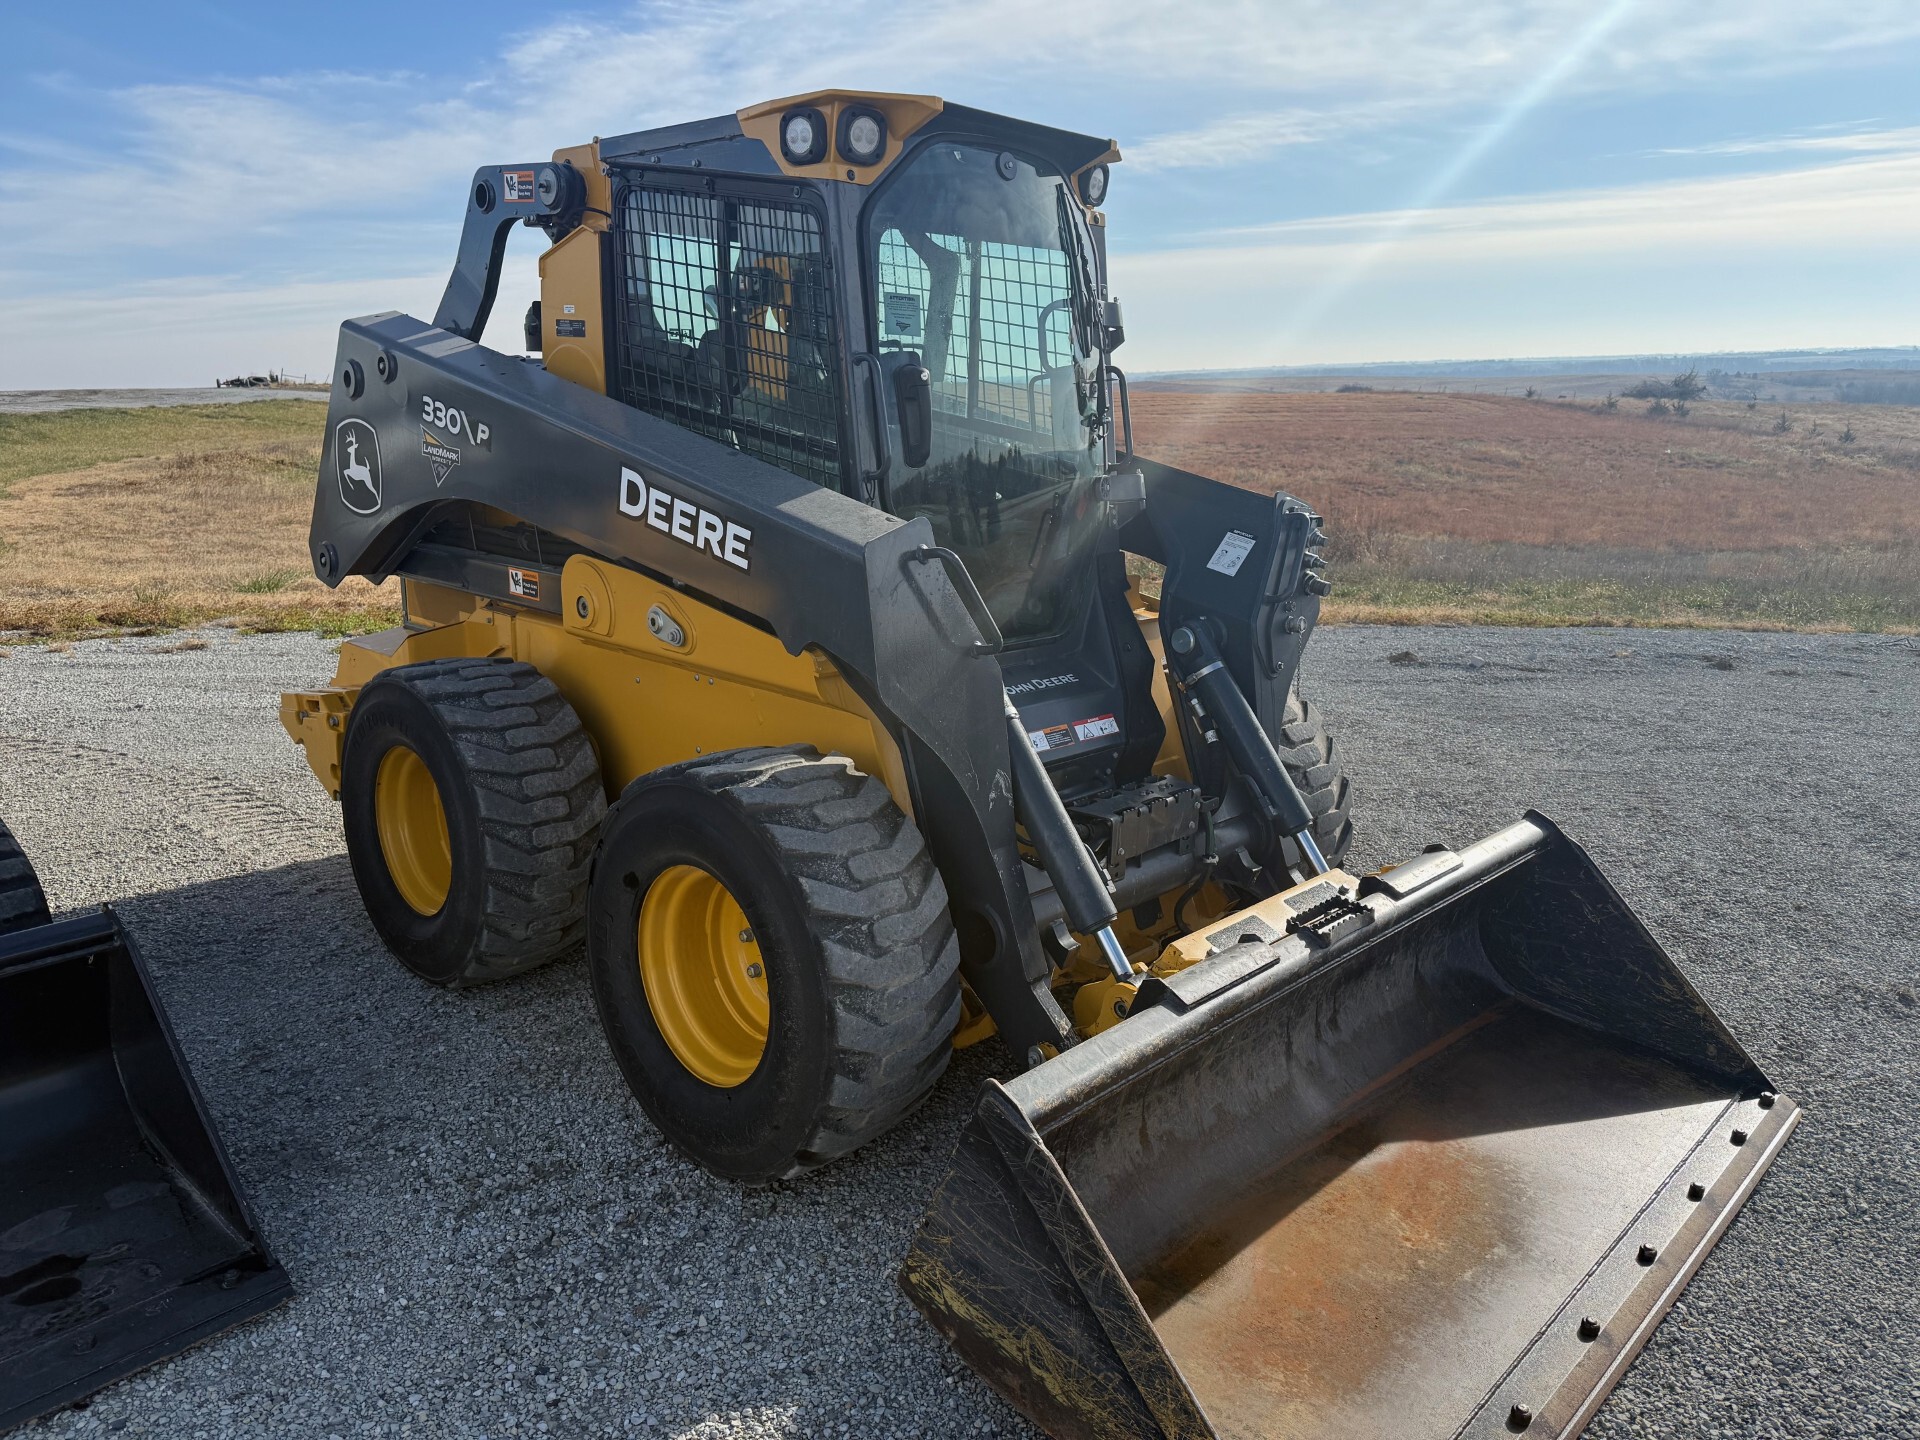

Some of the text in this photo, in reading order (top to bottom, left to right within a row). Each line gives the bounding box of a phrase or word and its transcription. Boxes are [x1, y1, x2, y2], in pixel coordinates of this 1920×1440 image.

[619, 466, 752, 570] DEERE
[1004, 673, 1079, 695] OHN DEERE
